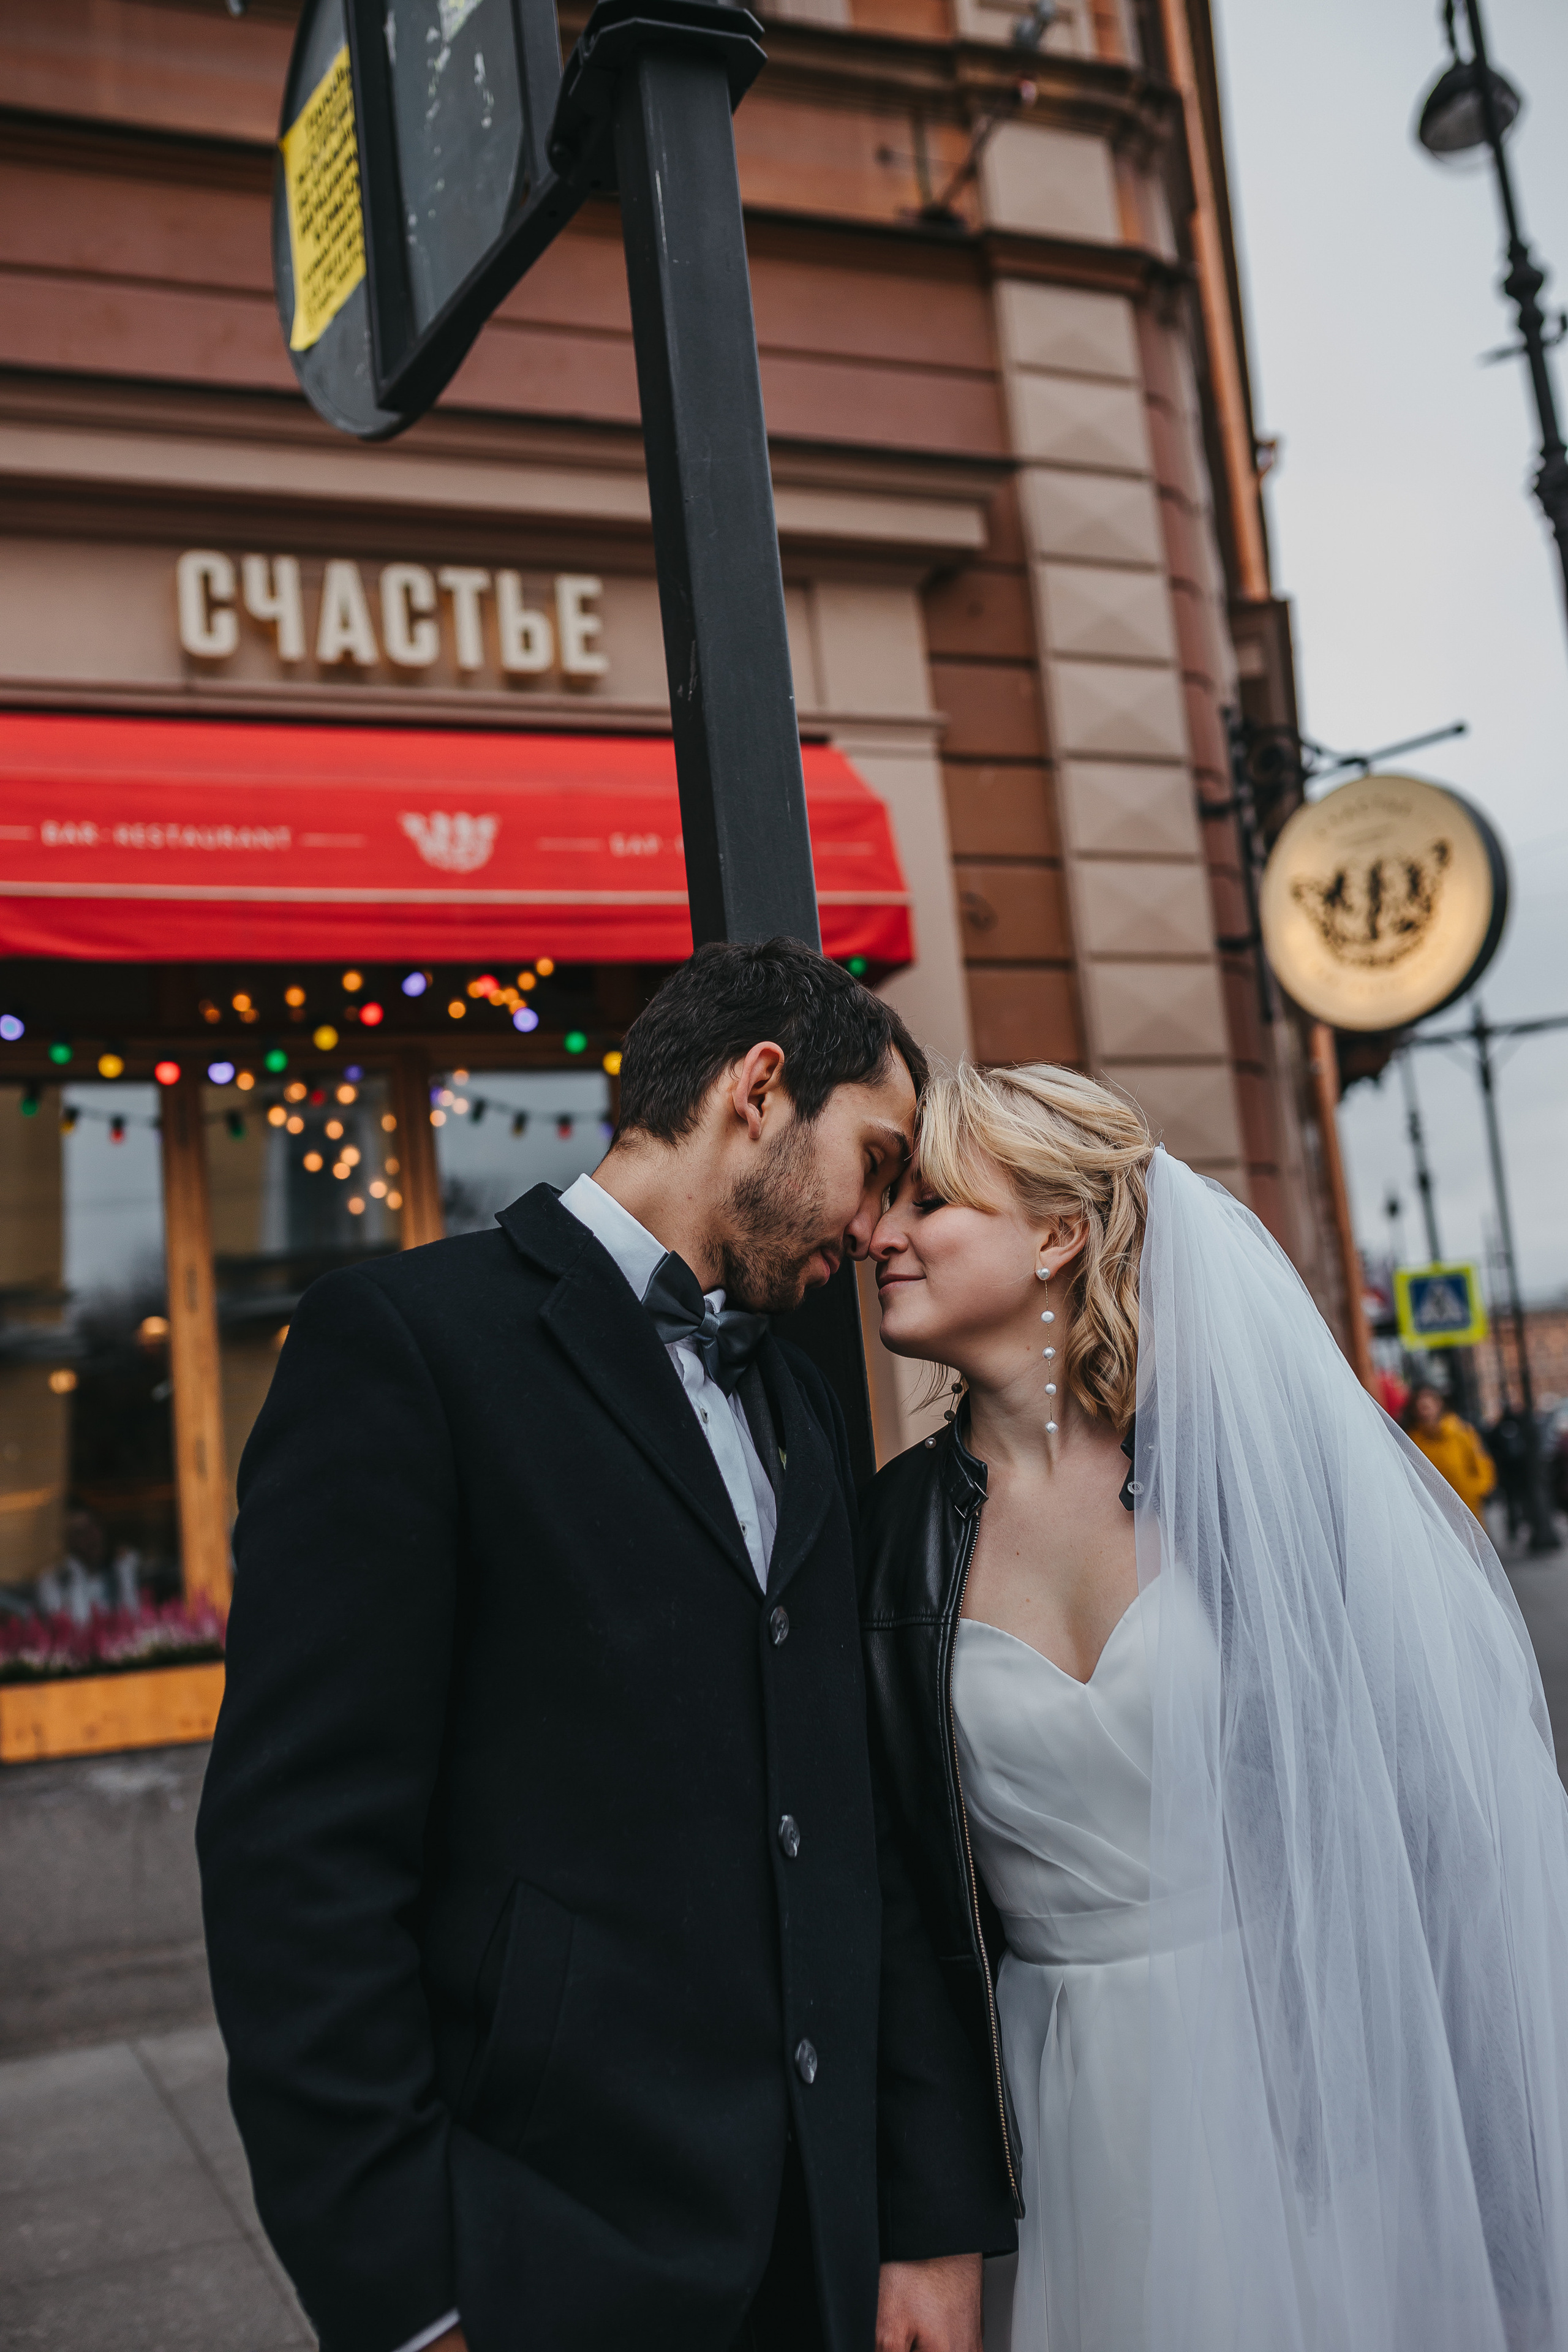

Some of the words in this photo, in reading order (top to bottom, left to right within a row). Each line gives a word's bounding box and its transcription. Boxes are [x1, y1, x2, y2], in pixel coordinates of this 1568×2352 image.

[177, 550, 609, 673] СЧАСТЬЕ
[41, 820, 98, 848] BAR
[113, 821, 292, 851] RESTAURANT
